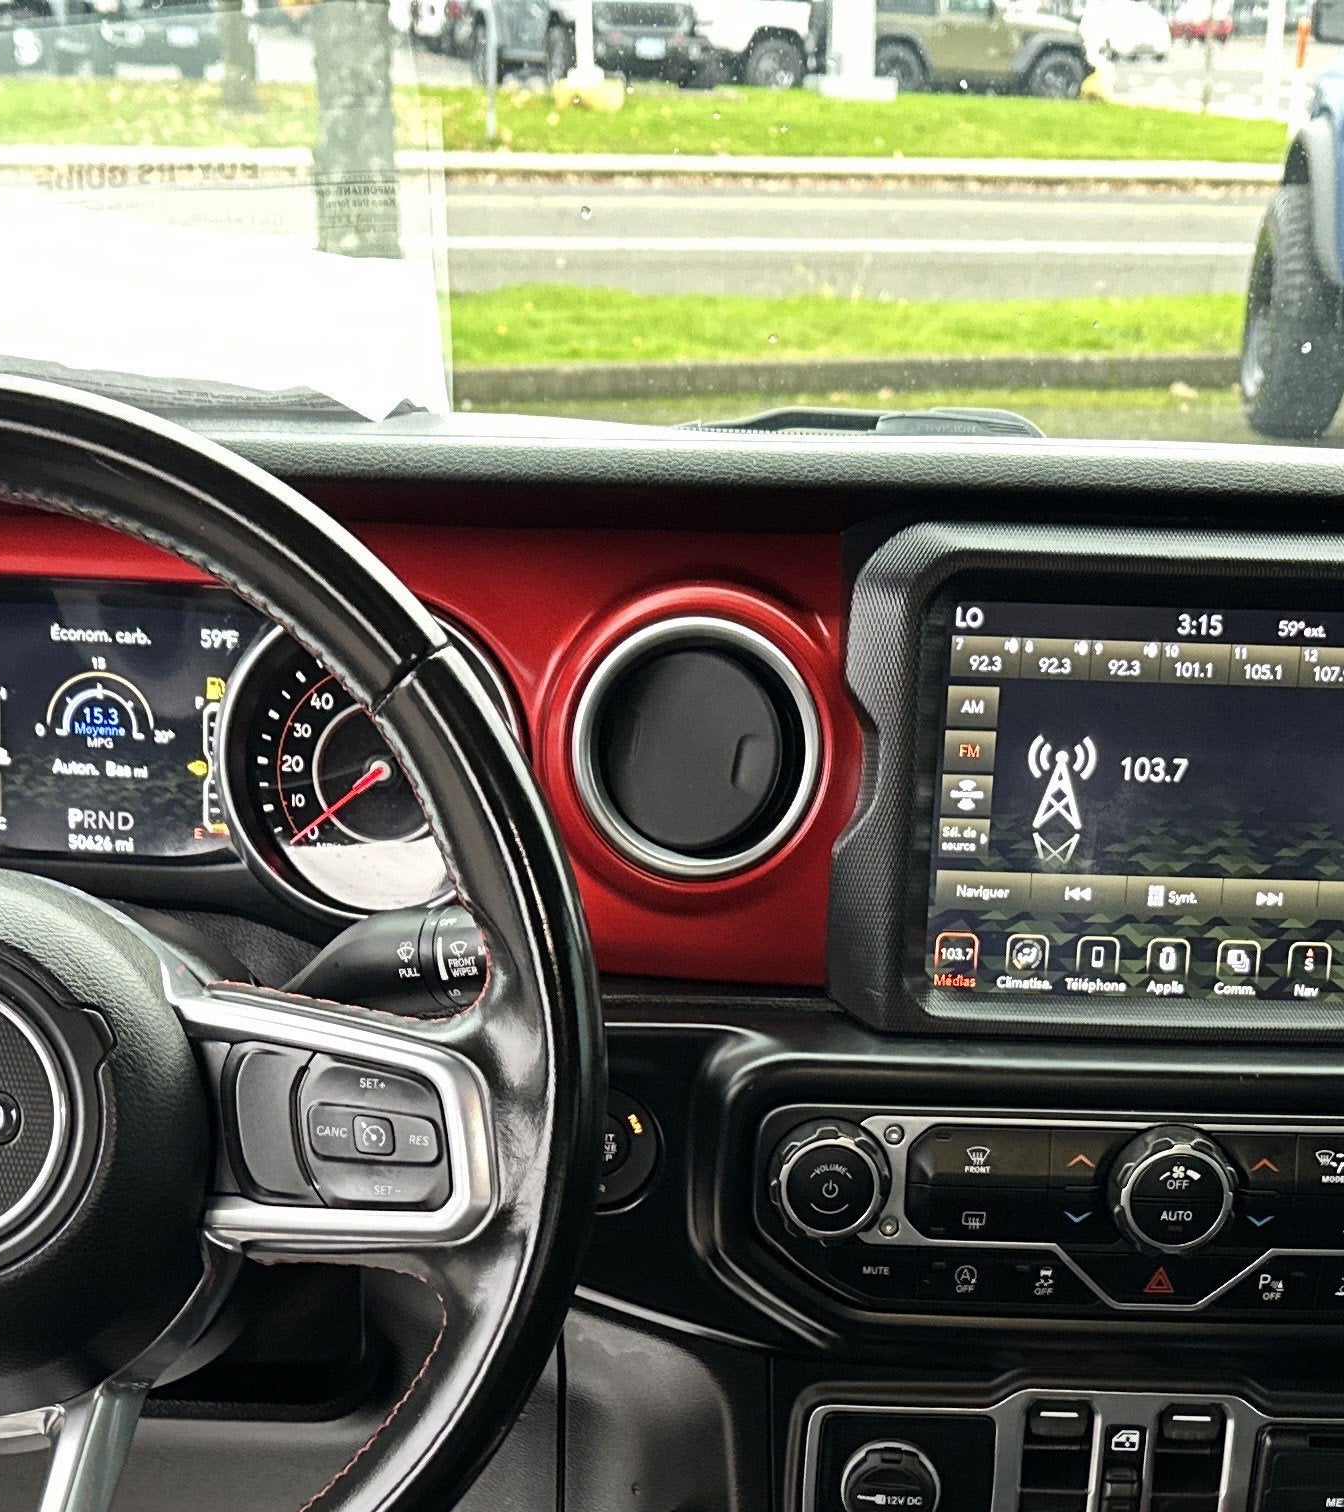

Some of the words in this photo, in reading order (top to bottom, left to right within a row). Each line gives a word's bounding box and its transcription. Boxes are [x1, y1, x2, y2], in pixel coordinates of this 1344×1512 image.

[955, 606, 984, 628] LO
[1177, 613, 1223, 636] 3:15
[115, 628, 152, 645] carb.
[956, 638, 964, 650] 7
[1094, 642, 1103, 655] 9
[1165, 645, 1179, 657] 10
[1234, 647, 1247, 659] 11
[1304, 650, 1318, 662] 12
[969, 655, 1002, 672] 92.3
[1038, 657, 1071, 674] 92.3
[1108, 659, 1141, 676] 92.3
[1174, 662, 1213, 678] 101.1
[1243, 664, 1282, 680] 105.1
[310, 692, 334, 710] 40
[961, 700, 985, 714] AM
[83, 707, 119, 725] 15.3
[35, 723, 46, 737] 0
[74, 723, 126, 738] Moyenne
[293, 723, 312, 738] 30
[86, 737, 114, 749] MPG
[959, 744, 980, 758] FM
[281, 755, 304, 773] 20
[1120, 756, 1189, 783] 103.7
[291, 794, 305, 807] 10
[194, 828, 204, 839] E
[68, 833, 114, 850] 50626
[116, 837, 134, 851] mi
[956, 884, 1010, 900] Naviguer
[1168, 891, 1197, 906] Synt.
[940, 947, 974, 961] 103.7
[448, 956, 476, 968] FRONT
[1304, 957, 1314, 971] S
[398, 967, 420, 979] PULL
[451, 966, 479, 978] WIPER
[934, 973, 977, 988] Médias
[1065, 977, 1127, 994] Téléphone
[1214, 982, 1256, 996] Comm.
[1294, 985, 1319, 998] Nav
[316, 1125, 348, 1139] CANC
[408, 1134, 430, 1147] RES
[813, 1163, 848, 1176] VOLUME
[964, 1165, 990, 1175] FRONT
[1166, 1179, 1190, 1190] OFF
[1160, 1210, 1193, 1222] AUTO
[862, 1266, 890, 1276] MUTE
[956, 1285, 975, 1293] OFF
[1034, 1286, 1054, 1295] OFF
[1262, 1291, 1282, 1301] OFF
[886, 1496, 905, 1506] 12V
[906, 1496, 923, 1506] DC
